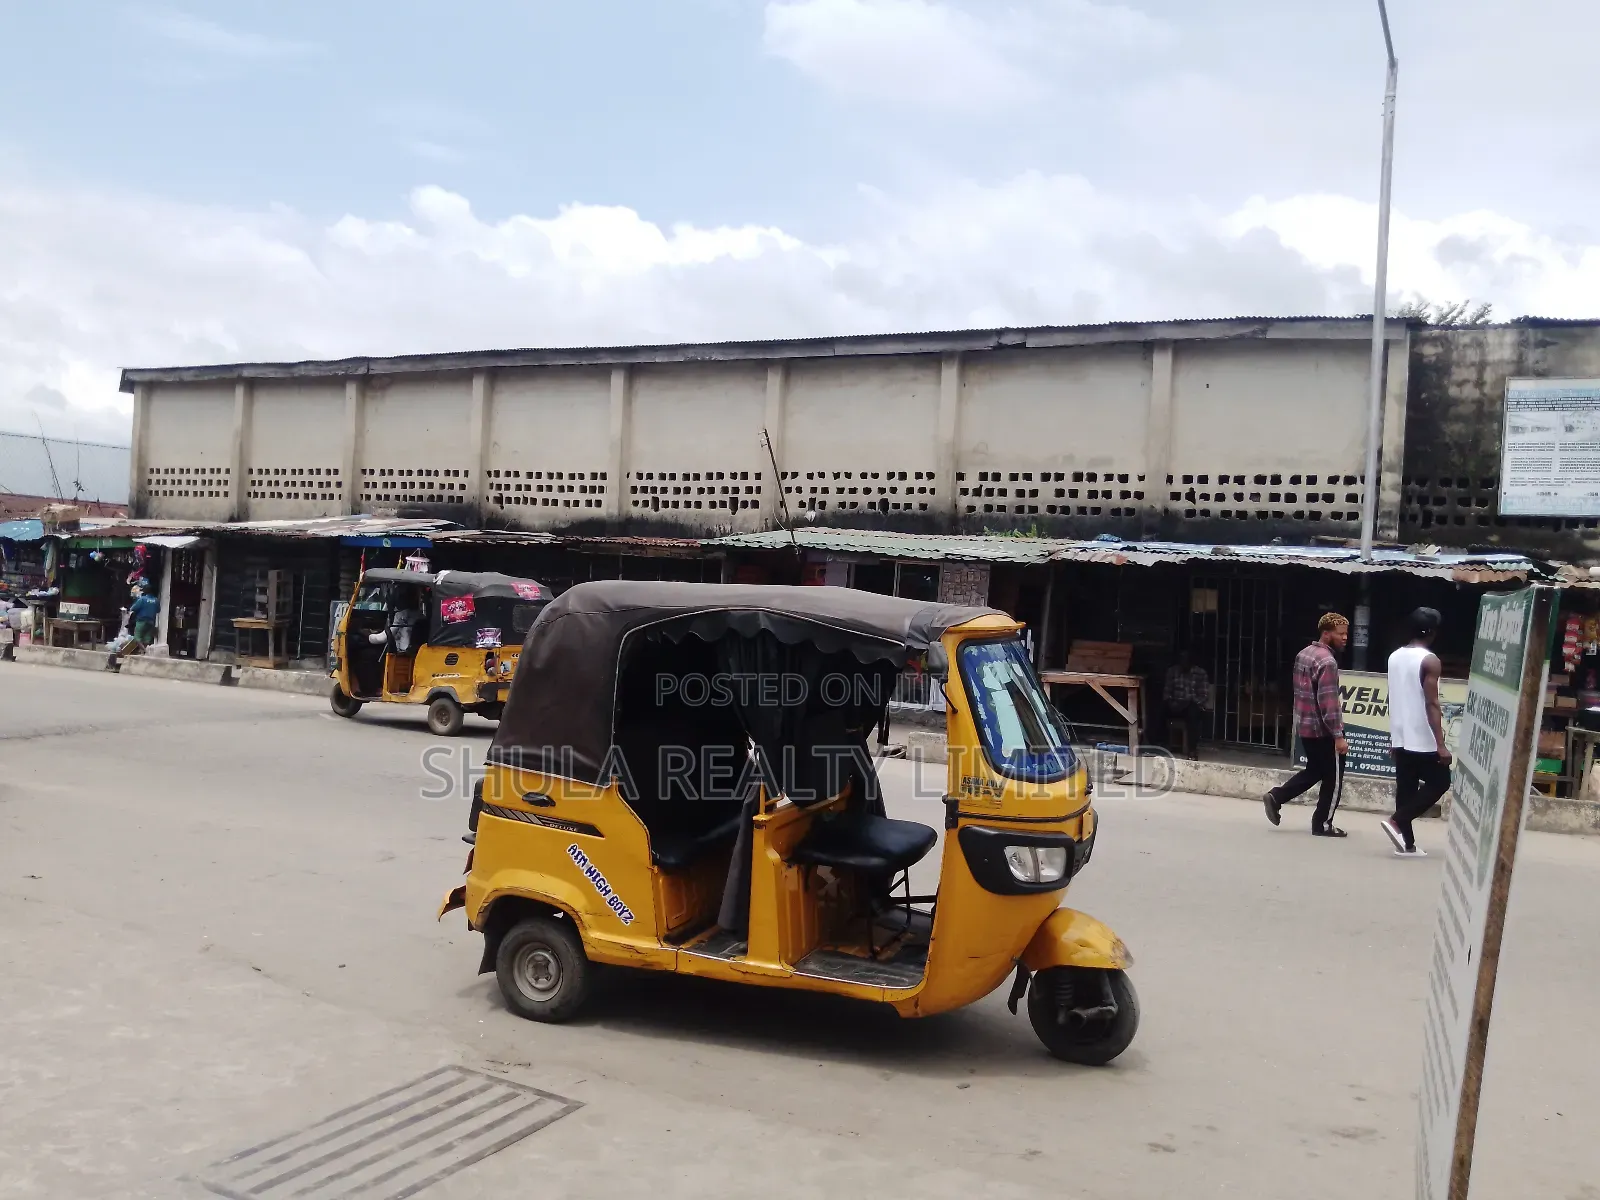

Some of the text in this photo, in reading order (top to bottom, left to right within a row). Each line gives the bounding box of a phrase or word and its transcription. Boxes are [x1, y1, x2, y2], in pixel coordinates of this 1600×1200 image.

[1338, 685, 1389, 704] WEL
[1341, 701, 1389, 717] LDIN
[1468, 722, 1496, 774] AGENT
[550, 823, 577, 832] DELUXE
[567, 844, 634, 925] AIM HIGH BOYZ
